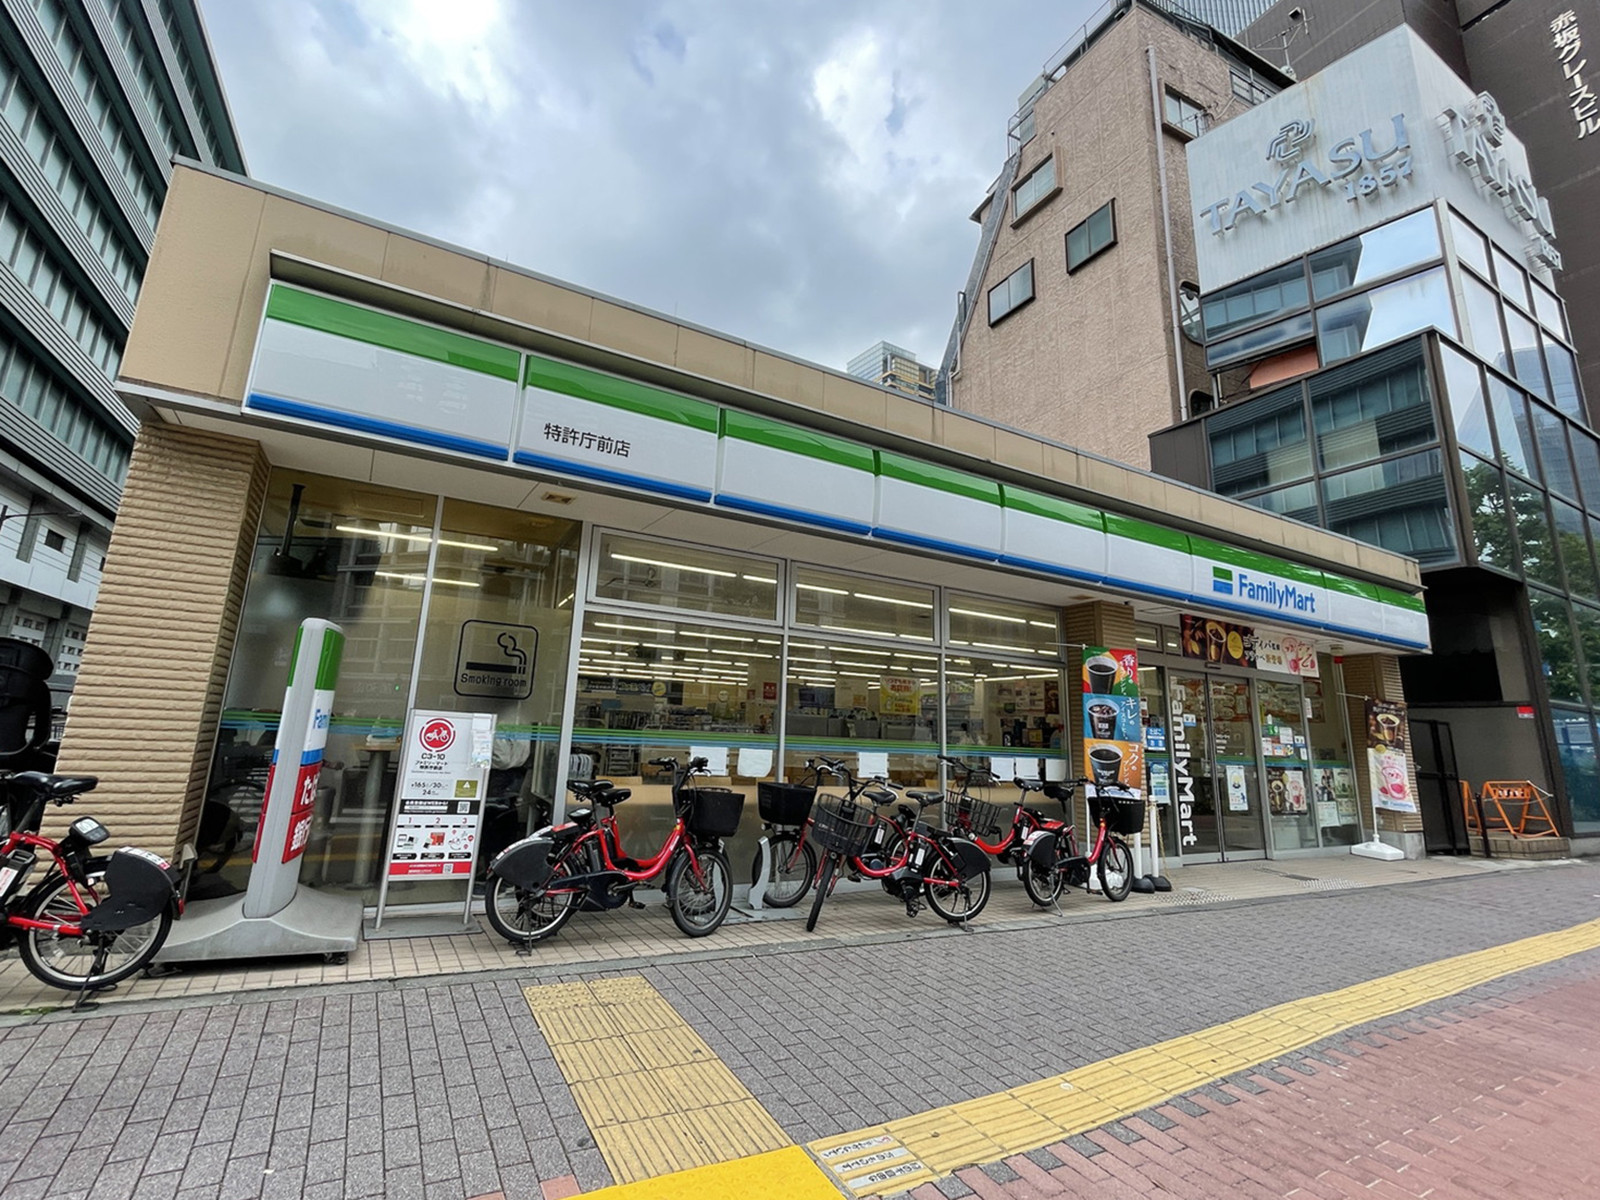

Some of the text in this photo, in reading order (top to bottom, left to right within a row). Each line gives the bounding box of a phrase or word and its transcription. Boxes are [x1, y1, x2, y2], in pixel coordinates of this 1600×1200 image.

[1549, 9, 1600, 140] 赤坂グレースビル
[1200, 113, 1410, 236] TAYASU
[1346, 156, 1413, 203] 1857
[543, 422, 631, 458] 特許庁前店
[1238, 573, 1316, 613] FamilyMart
[460, 672, 526, 688] Smoking room
[1172, 684, 1198, 847] FamilyMart
